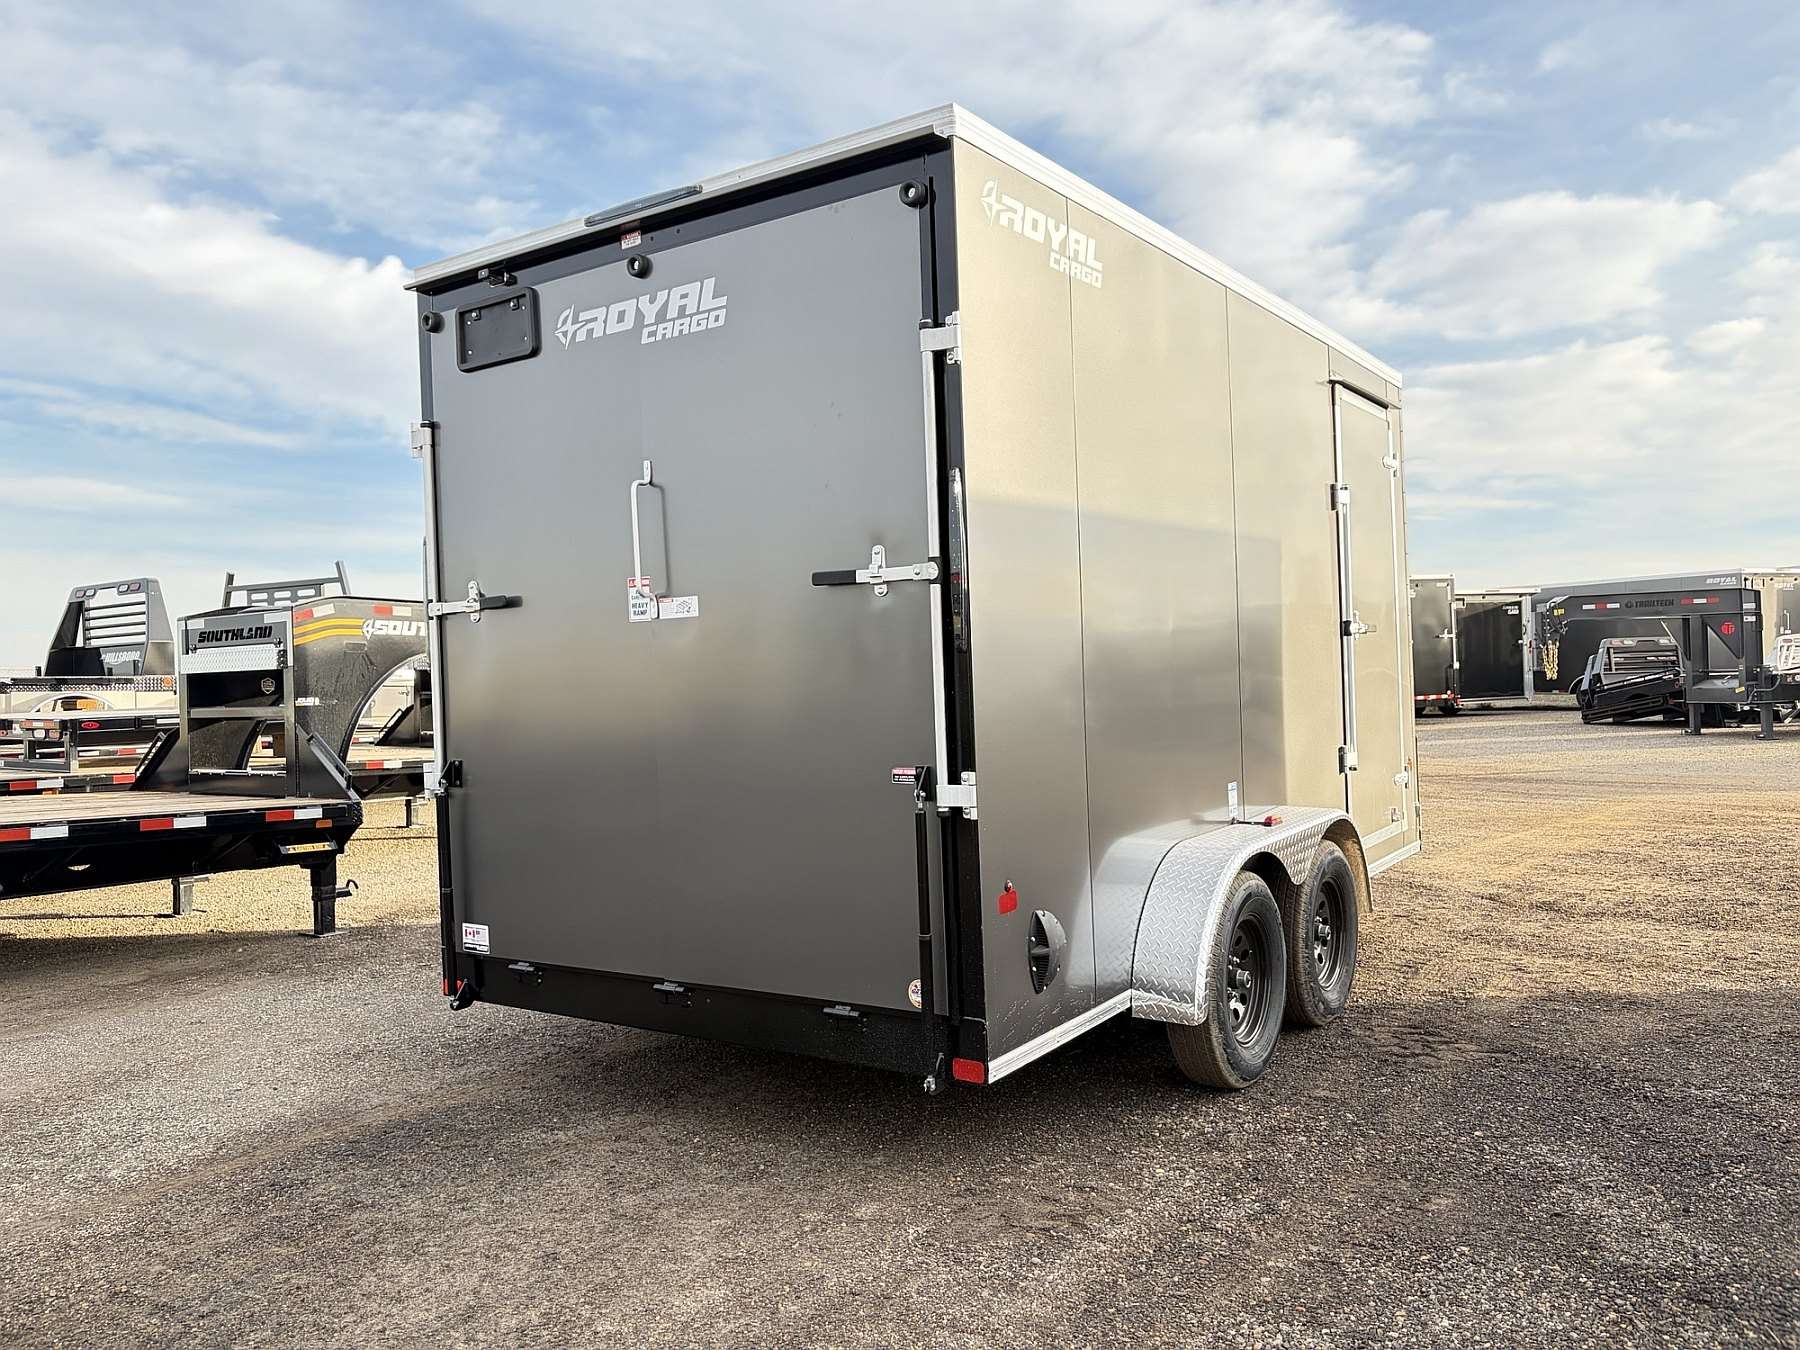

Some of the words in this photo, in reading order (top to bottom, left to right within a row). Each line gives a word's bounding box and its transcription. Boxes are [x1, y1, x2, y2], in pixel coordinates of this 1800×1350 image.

[999, 193, 1103, 272] ROYAL
[1049, 250, 1103, 289] CARGO
[575, 277, 728, 344] ROYAL
[641, 308, 727, 344] CARGO
[197, 625, 273, 643] SOUTHLAND
